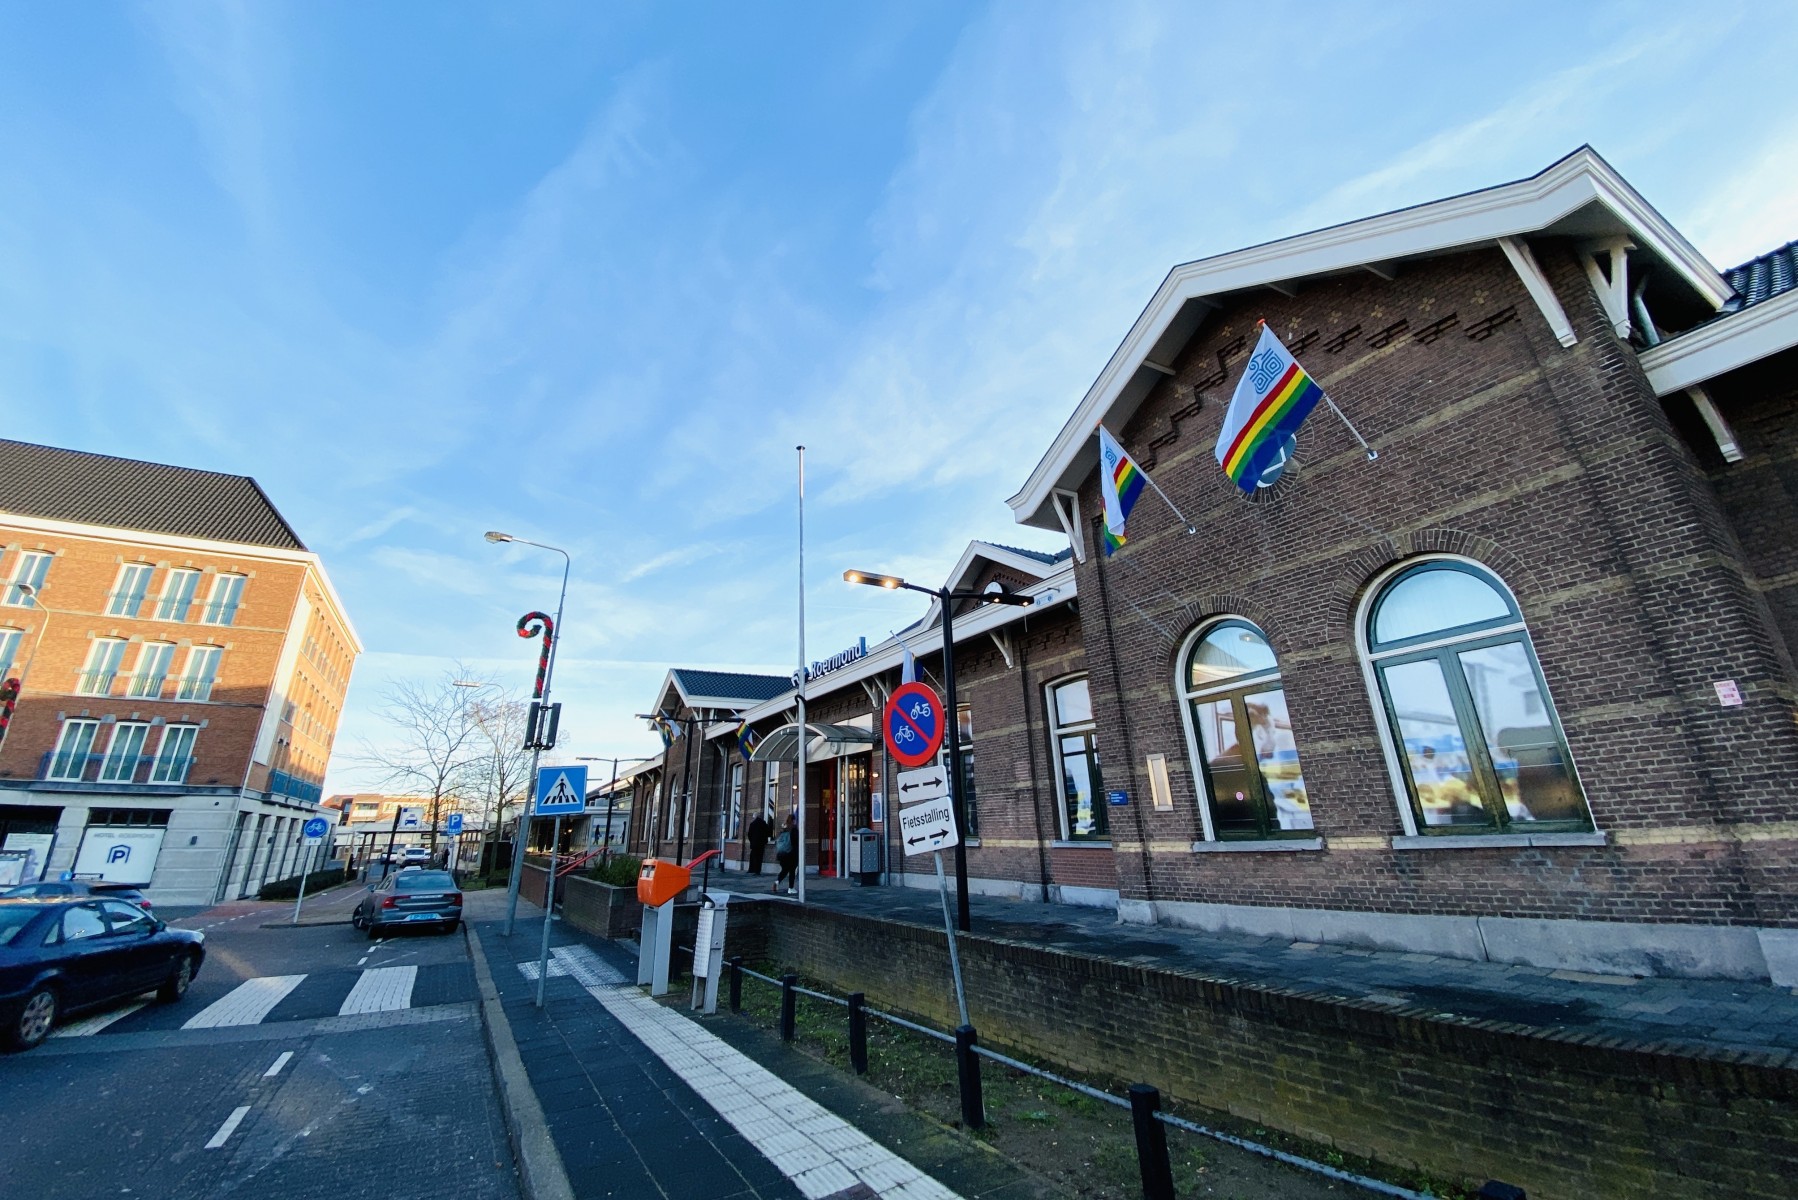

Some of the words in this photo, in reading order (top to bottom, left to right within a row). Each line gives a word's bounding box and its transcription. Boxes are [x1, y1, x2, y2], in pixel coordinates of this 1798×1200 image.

[810, 636, 866, 679] Roermond
[451, 815, 460, 826] P
[902, 808, 950, 830] Fietsstalling
[111, 850, 125, 863] P
